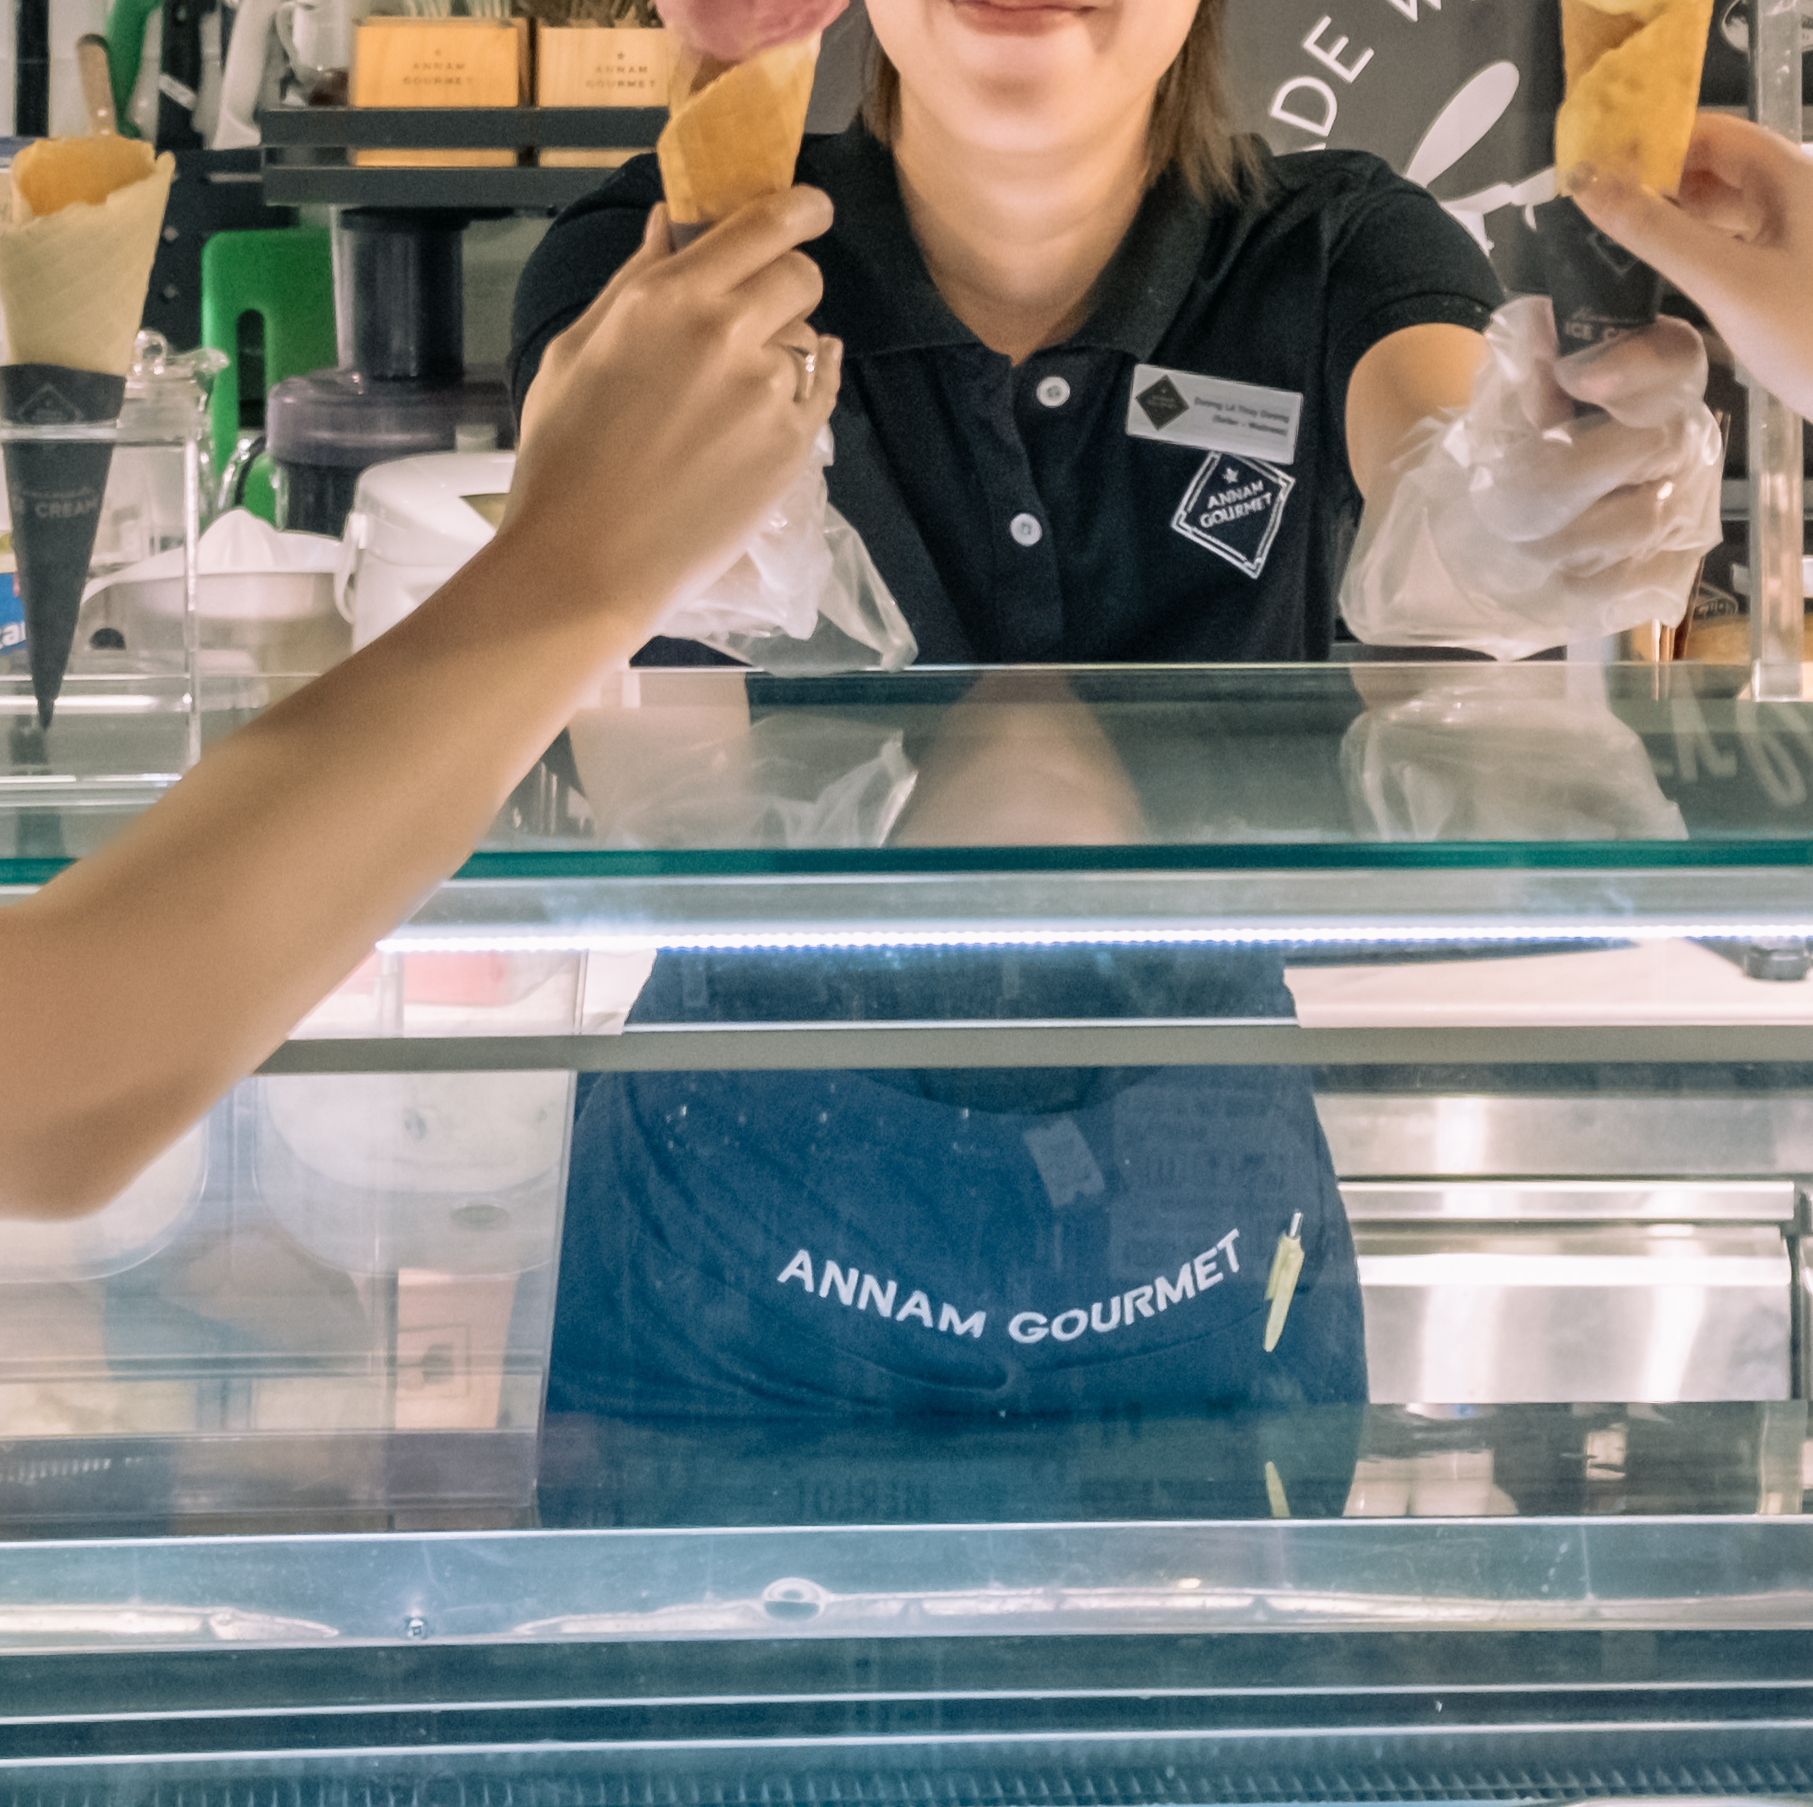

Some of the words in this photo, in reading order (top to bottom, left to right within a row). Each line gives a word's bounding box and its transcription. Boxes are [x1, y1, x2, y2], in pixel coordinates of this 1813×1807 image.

[585, 79, 657, 89] GOURMET
[594, 65, 649, 74] ANNAM
[1268, 15, 1375, 151] DE
[35, 496, 99, 519] CREAM
[1206, 479, 1264, 510] ANNAM
[1199, 492, 1272, 529] GOURMET
[776, 1248, 987, 1340] ANNAM
[1008, 1227, 1241, 1344] GOURMET
